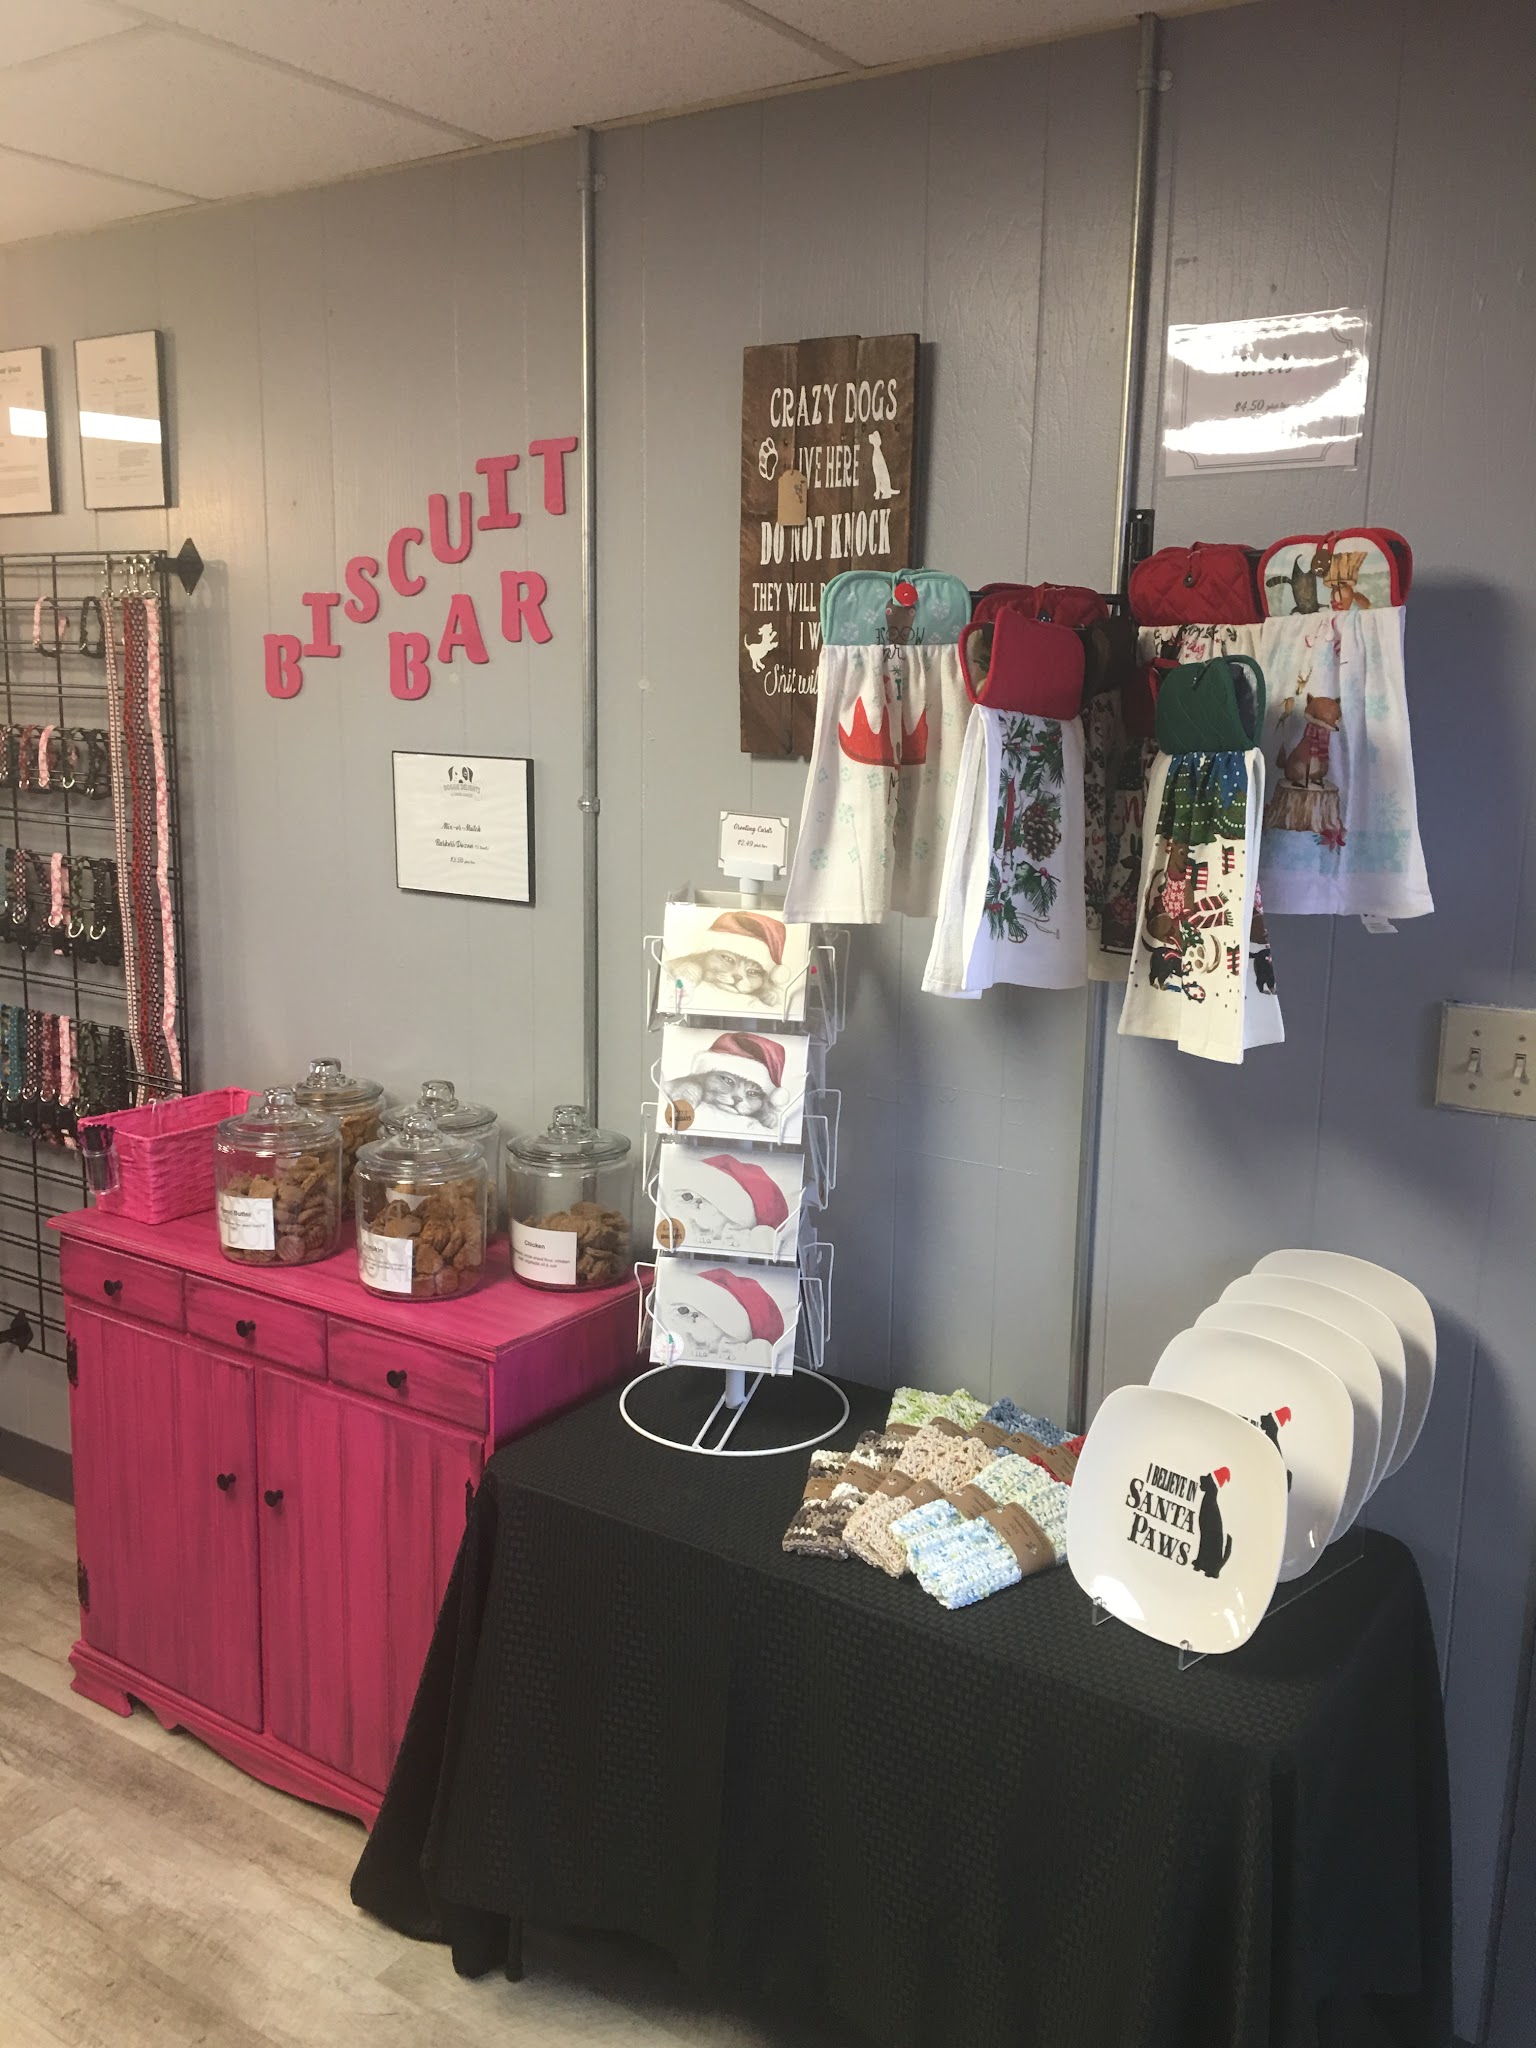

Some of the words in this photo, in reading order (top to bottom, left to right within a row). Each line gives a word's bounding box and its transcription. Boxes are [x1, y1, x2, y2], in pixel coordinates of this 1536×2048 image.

[770, 384, 838, 427] CRAZY
[845, 378, 897, 423] DOGS
[1234, 399, 1265, 412] $4.50
[796, 446, 823, 489] IVE
[825, 444, 860, 488] HERE
[760, 521, 785, 565] DO
[790, 516, 825, 563] NOT
[830, 508, 891, 559] KNOCK
[263, 436, 578, 700] BISCUIT
[752, 582, 782, 612] THEY
[786, 582, 817, 612] WILL
[388, 570, 554, 701] BAR
[799, 621, 804, 650] I
[734, 823, 756, 834] Greeting
[757, 825, 773, 834] Cards
[737, 839, 754, 847] $2.49
[524, 1240, 546, 1250] Chicken
[1146, 1462, 1154, 1484] I
[1151, 1466, 1189, 1498] BELIEVE
[1186, 1479, 1198, 1502] IN
[1125, 1478, 1196, 1535] SANTA
[1127, 1511, 1191, 1566] PAWS
